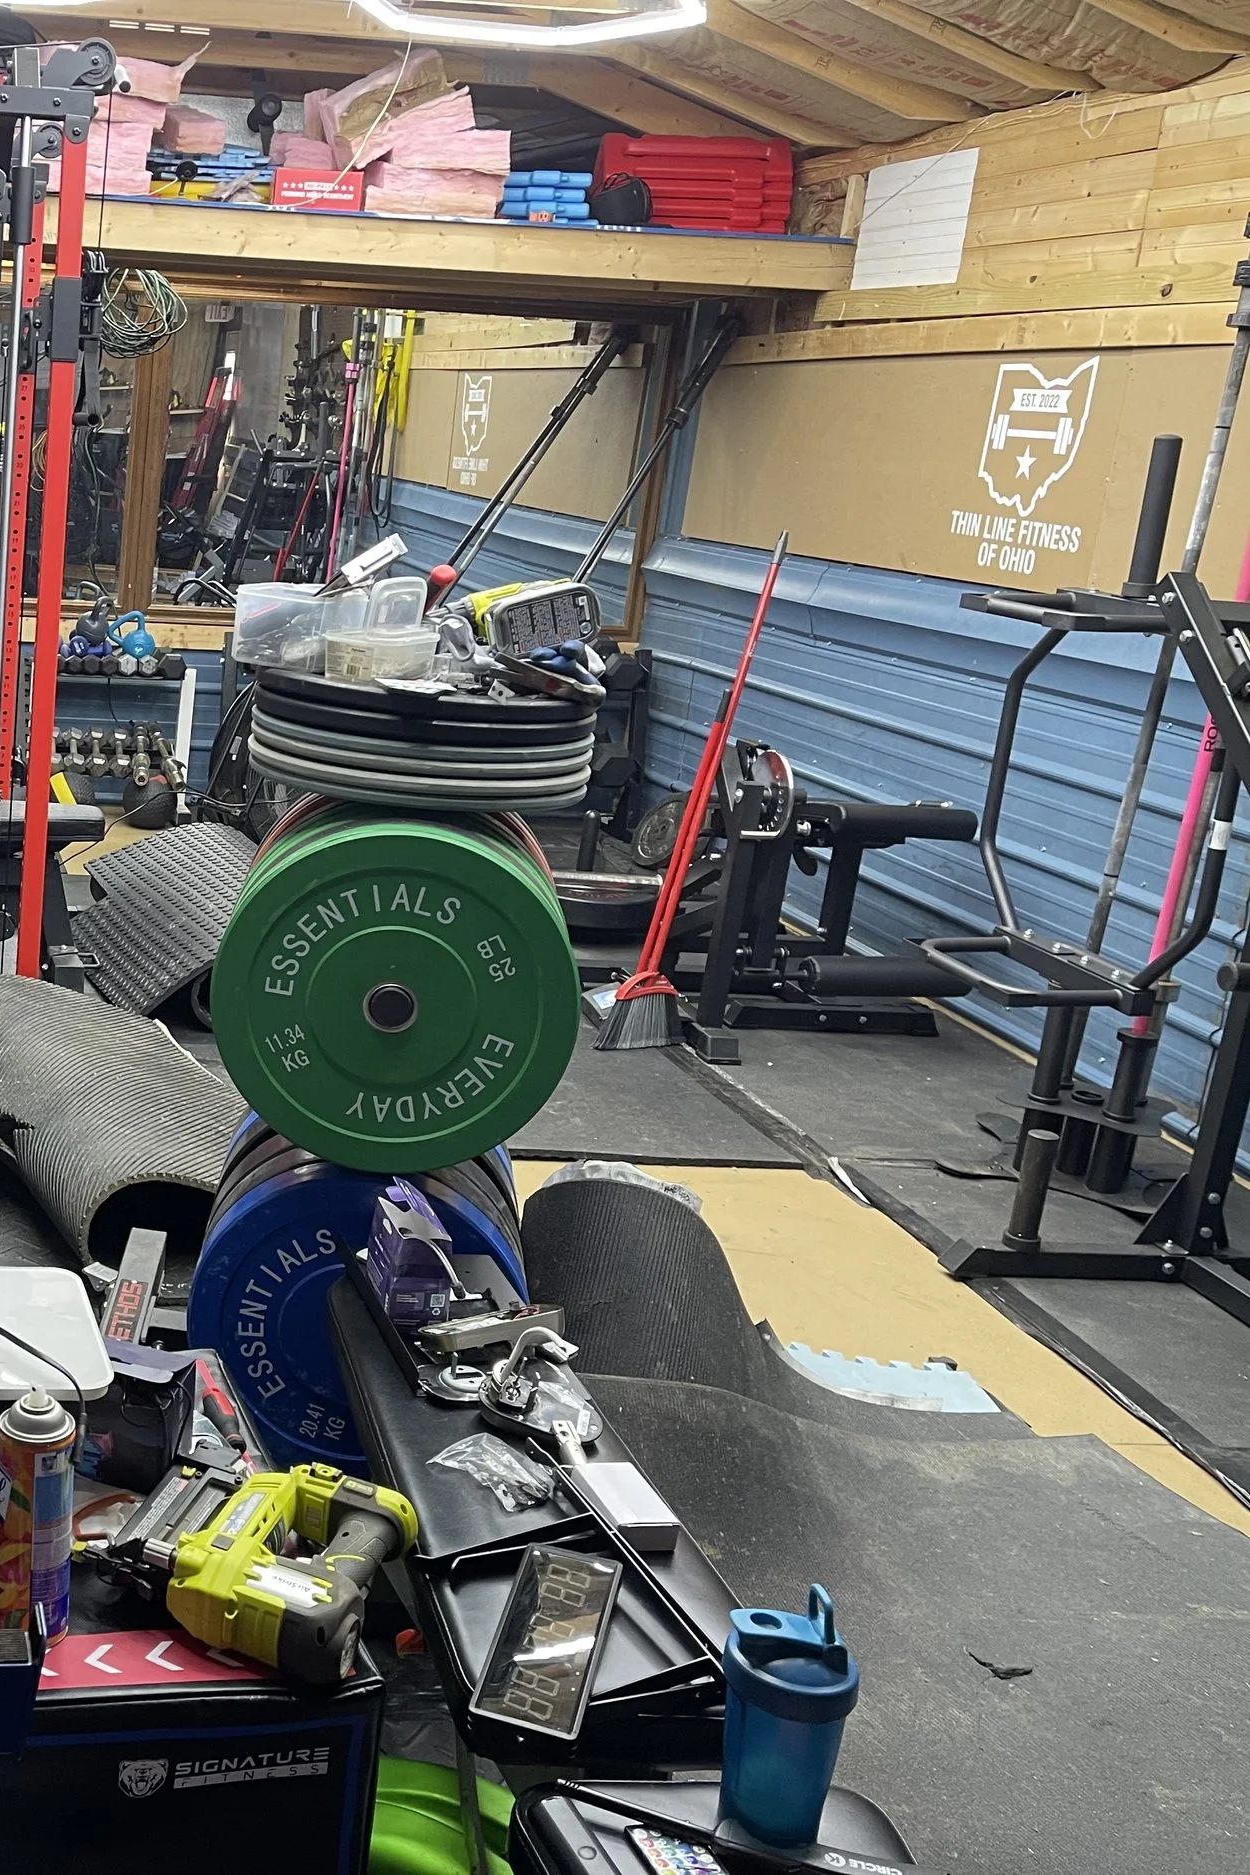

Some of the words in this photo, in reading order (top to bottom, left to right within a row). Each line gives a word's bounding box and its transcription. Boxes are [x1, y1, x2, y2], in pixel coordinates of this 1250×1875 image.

[1020, 393, 1037, 408] EST.
[1039, 394, 1060, 408] 2022
[951, 510, 982, 537] THIN
[983, 515, 1016, 543] LINE
[1018, 520, 1081, 553] FITNESS
[978, 542, 998, 567] OF
[1000, 545, 1036, 574] OHIO
[264, 884, 461, 996] ESSENTIALS
[476, 934, 507, 960] LB
[489, 956, 516, 982] 25
[264, 1023, 306, 1053] 11.34
[281, 1050, 311, 1072] KG
[345, 1033, 515, 1123] EVERYDAY
[107, 1281, 144, 1342] ETHOS
[238, 1229, 337, 1400] ESSENTIALS
[300, 1402, 326, 1439] 20.41
[323, 1416, 346, 1442] KG
[175, 1747, 330, 1775] SIGNATURE
[178, 1763, 323, 1788] FITNESS
